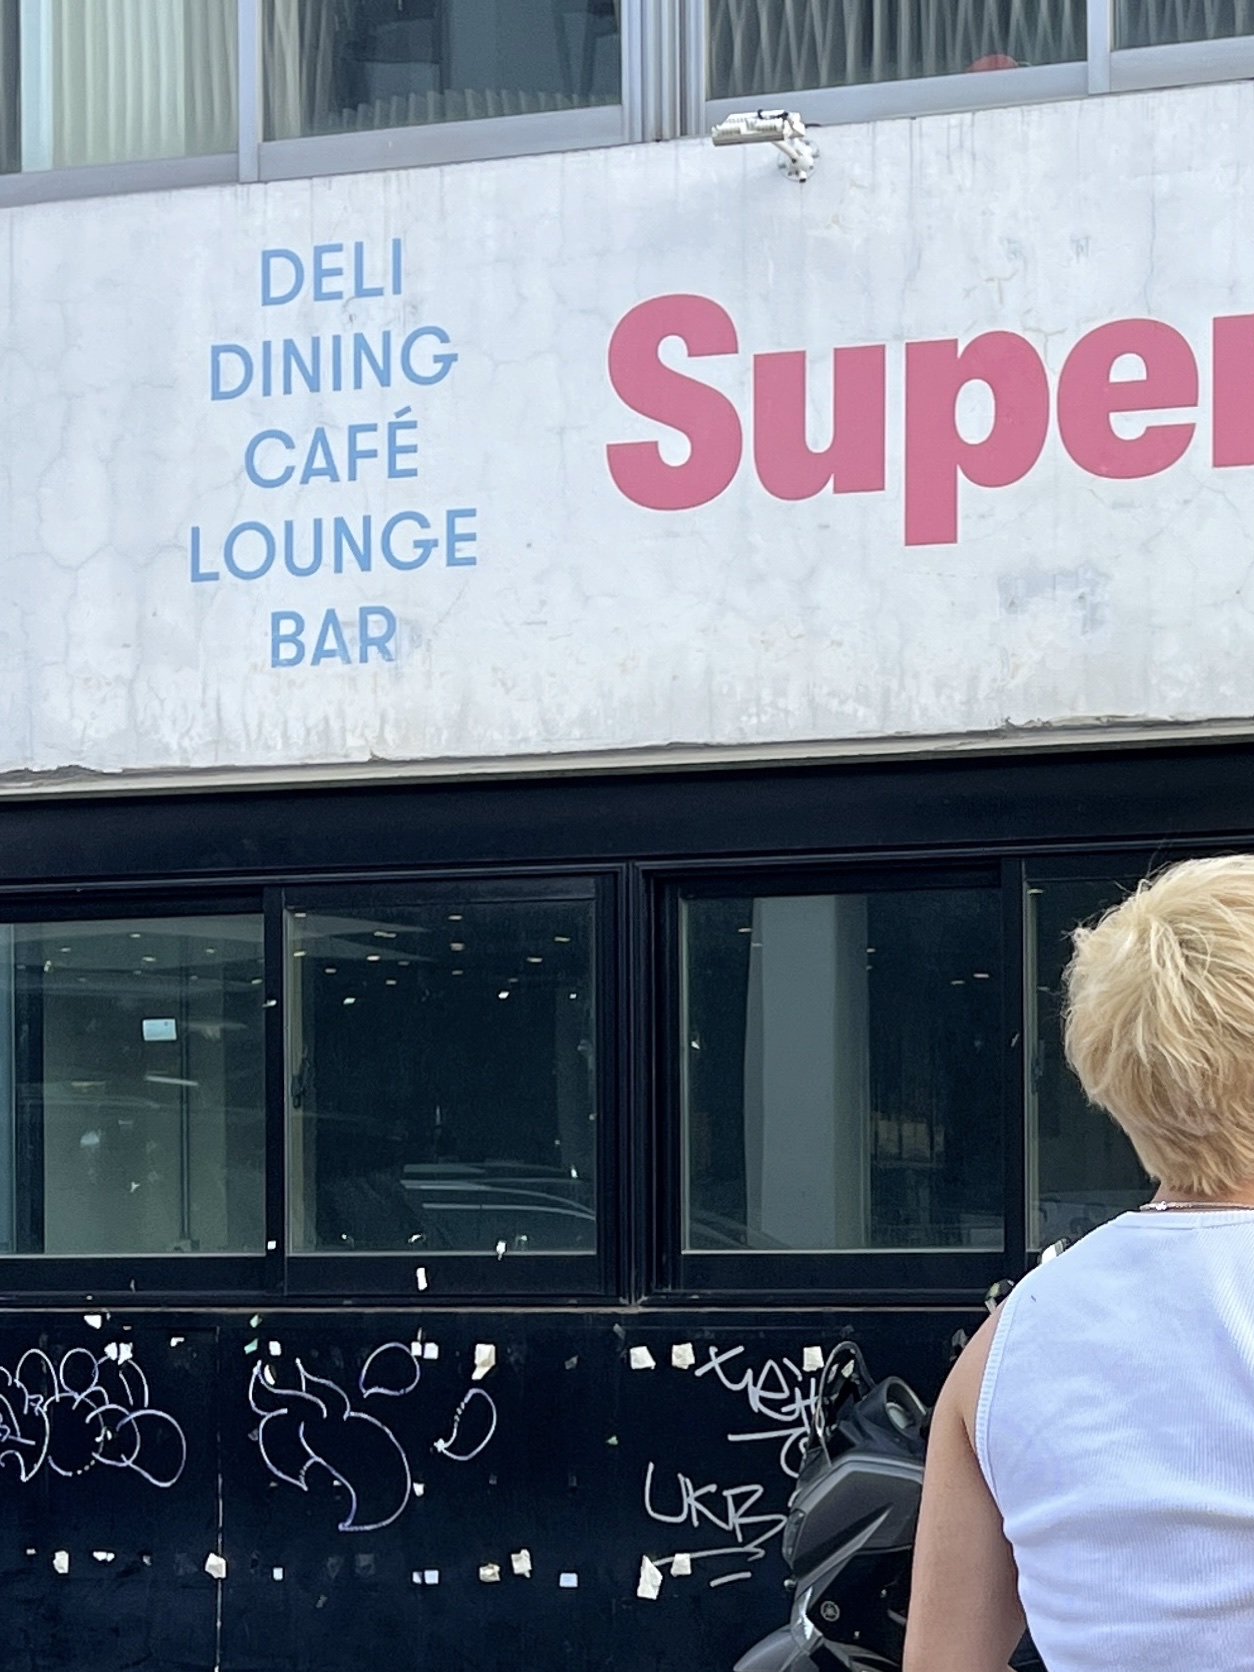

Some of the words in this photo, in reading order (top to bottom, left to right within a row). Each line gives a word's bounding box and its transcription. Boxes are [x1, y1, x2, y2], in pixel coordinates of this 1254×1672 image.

[261, 238, 402, 306] DELI
[210, 325, 459, 401] DINING
[244, 405, 418, 489] CAFÉ
[190, 508, 477, 583] LOUNGE
[270, 605, 397, 668] BAR
